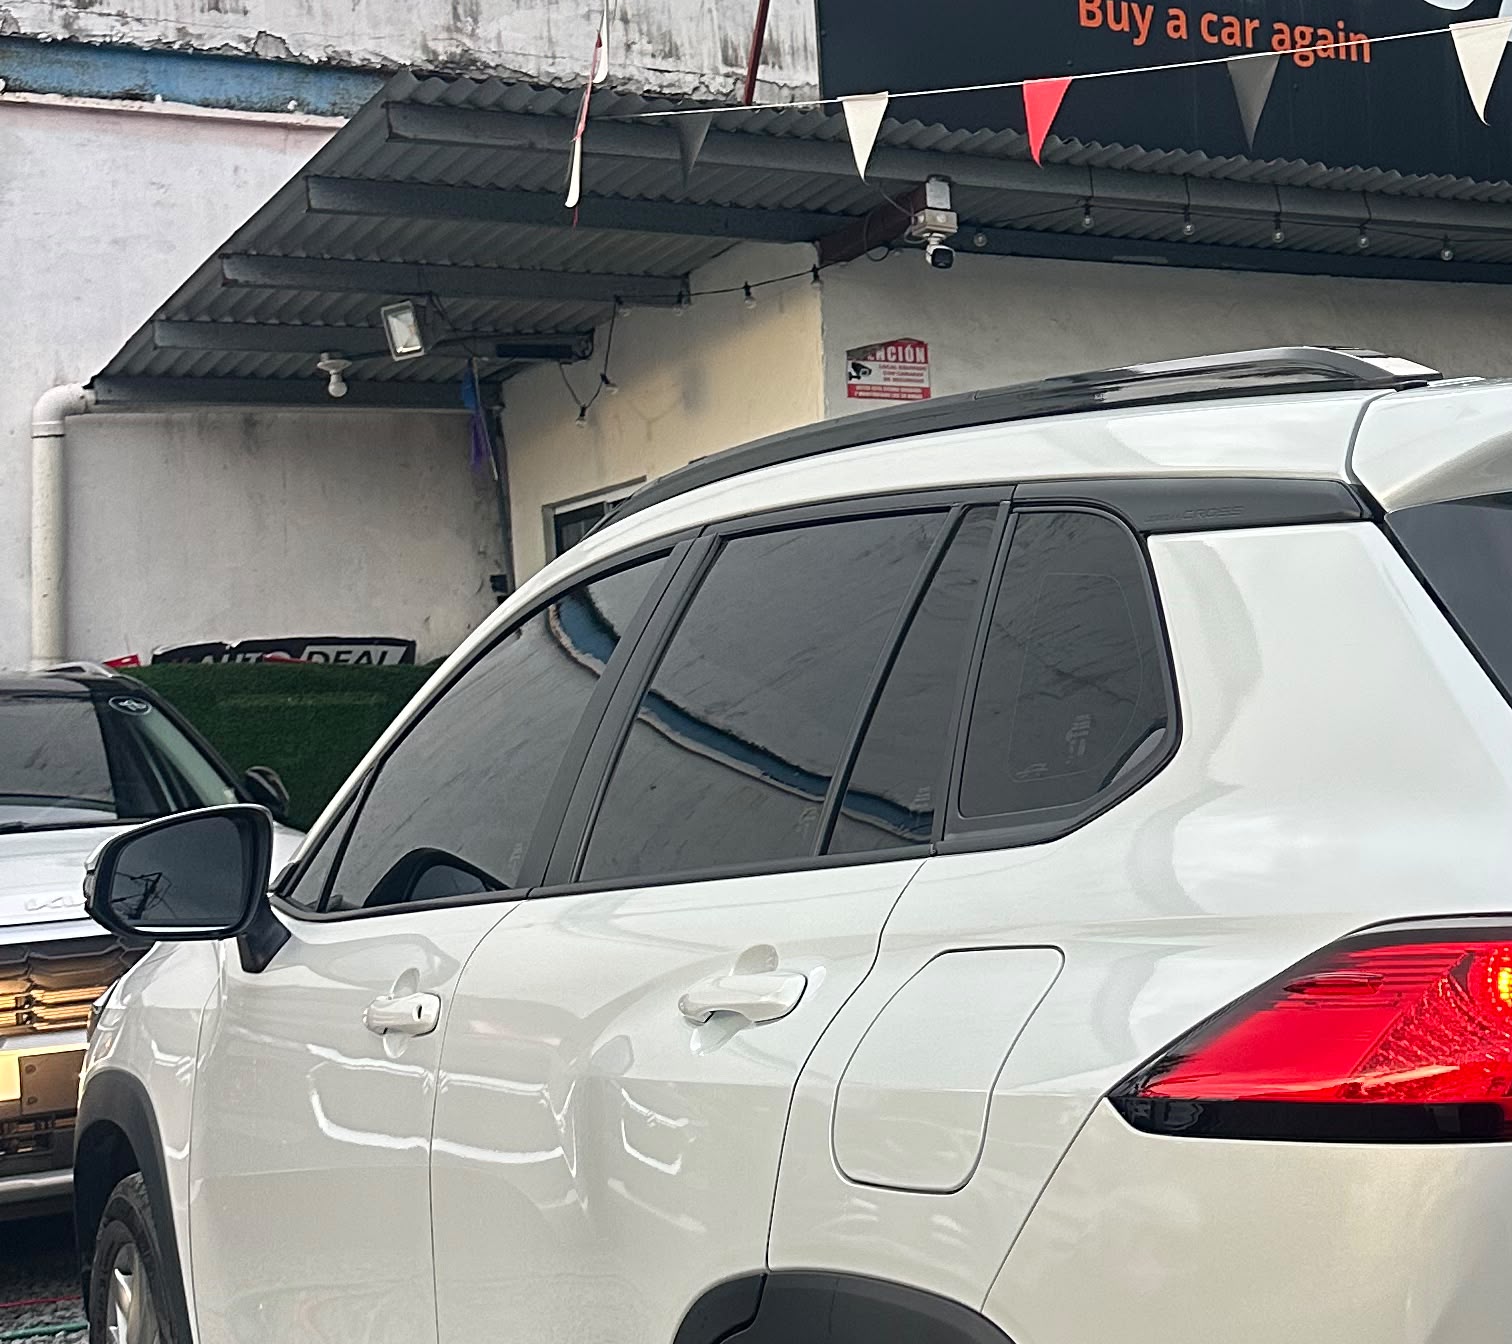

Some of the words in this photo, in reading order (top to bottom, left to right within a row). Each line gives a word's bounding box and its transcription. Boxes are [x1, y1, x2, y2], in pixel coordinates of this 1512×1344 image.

[1166, 7, 1188, 40] a
[1200, 11, 1261, 49] car
[1271, 20, 1372, 68] again
